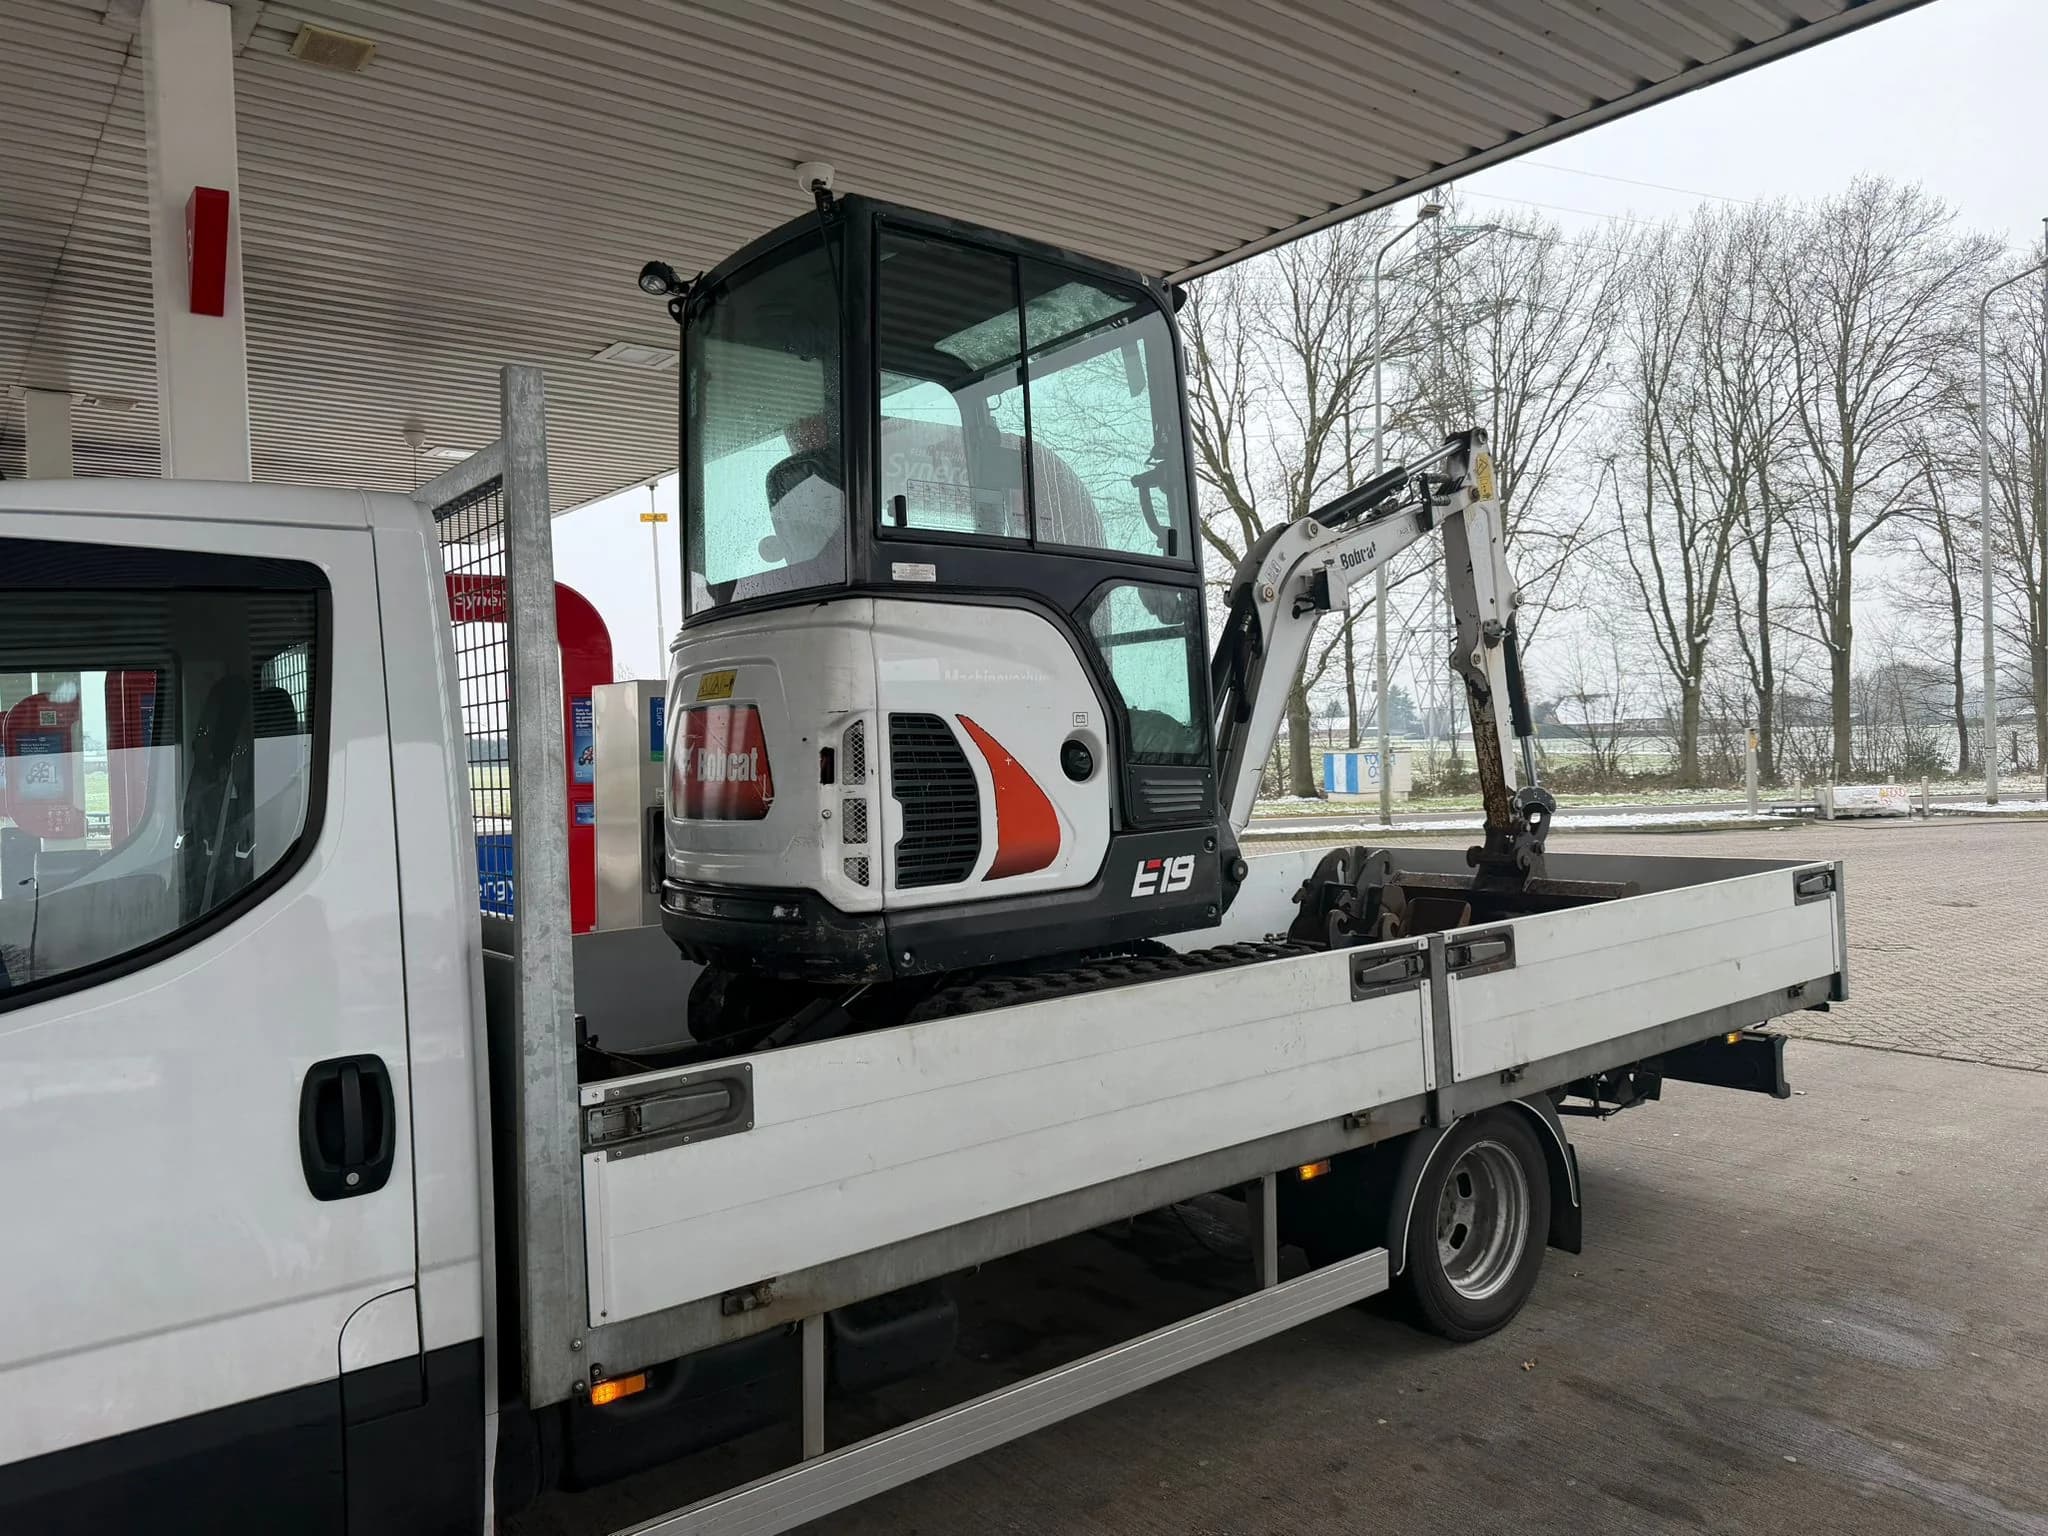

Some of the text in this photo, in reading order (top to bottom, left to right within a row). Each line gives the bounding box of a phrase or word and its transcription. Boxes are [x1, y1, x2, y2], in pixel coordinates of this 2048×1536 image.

[1340, 541, 1376, 570] Bobcat
[697, 747, 759, 782] Bobcat
[1130, 855, 1195, 898] E19
